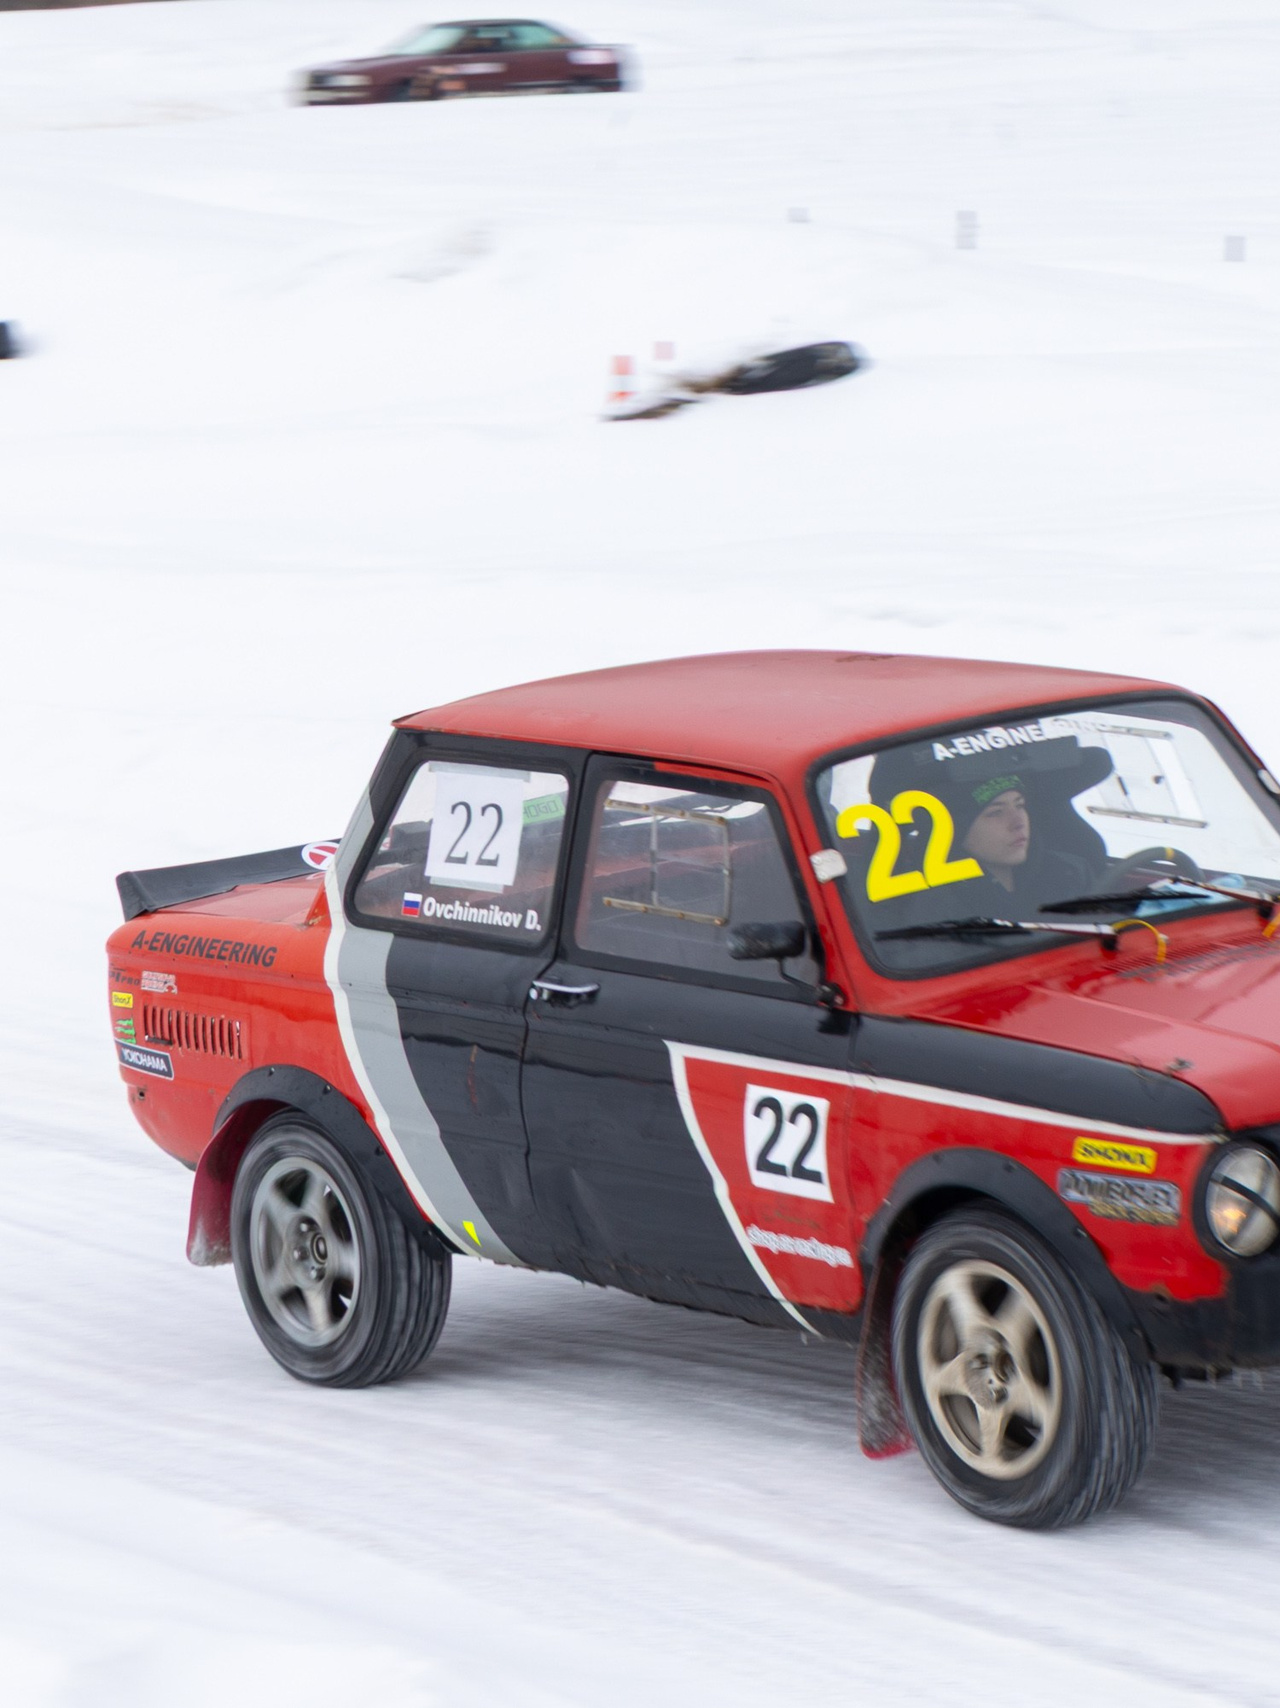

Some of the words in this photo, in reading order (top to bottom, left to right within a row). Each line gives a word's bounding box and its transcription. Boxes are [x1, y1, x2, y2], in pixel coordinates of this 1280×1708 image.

[444, 801, 504, 867] 22
[836, 790, 984, 902] 22
[423, 896, 522, 928] Ovchinnikov
[525, 909, 541, 930] D.
[132, 930, 278, 967] A-ENGINEERING
[121, 1047, 168, 1072] YOKOHAMA
[753, 1096, 824, 1183] 22
